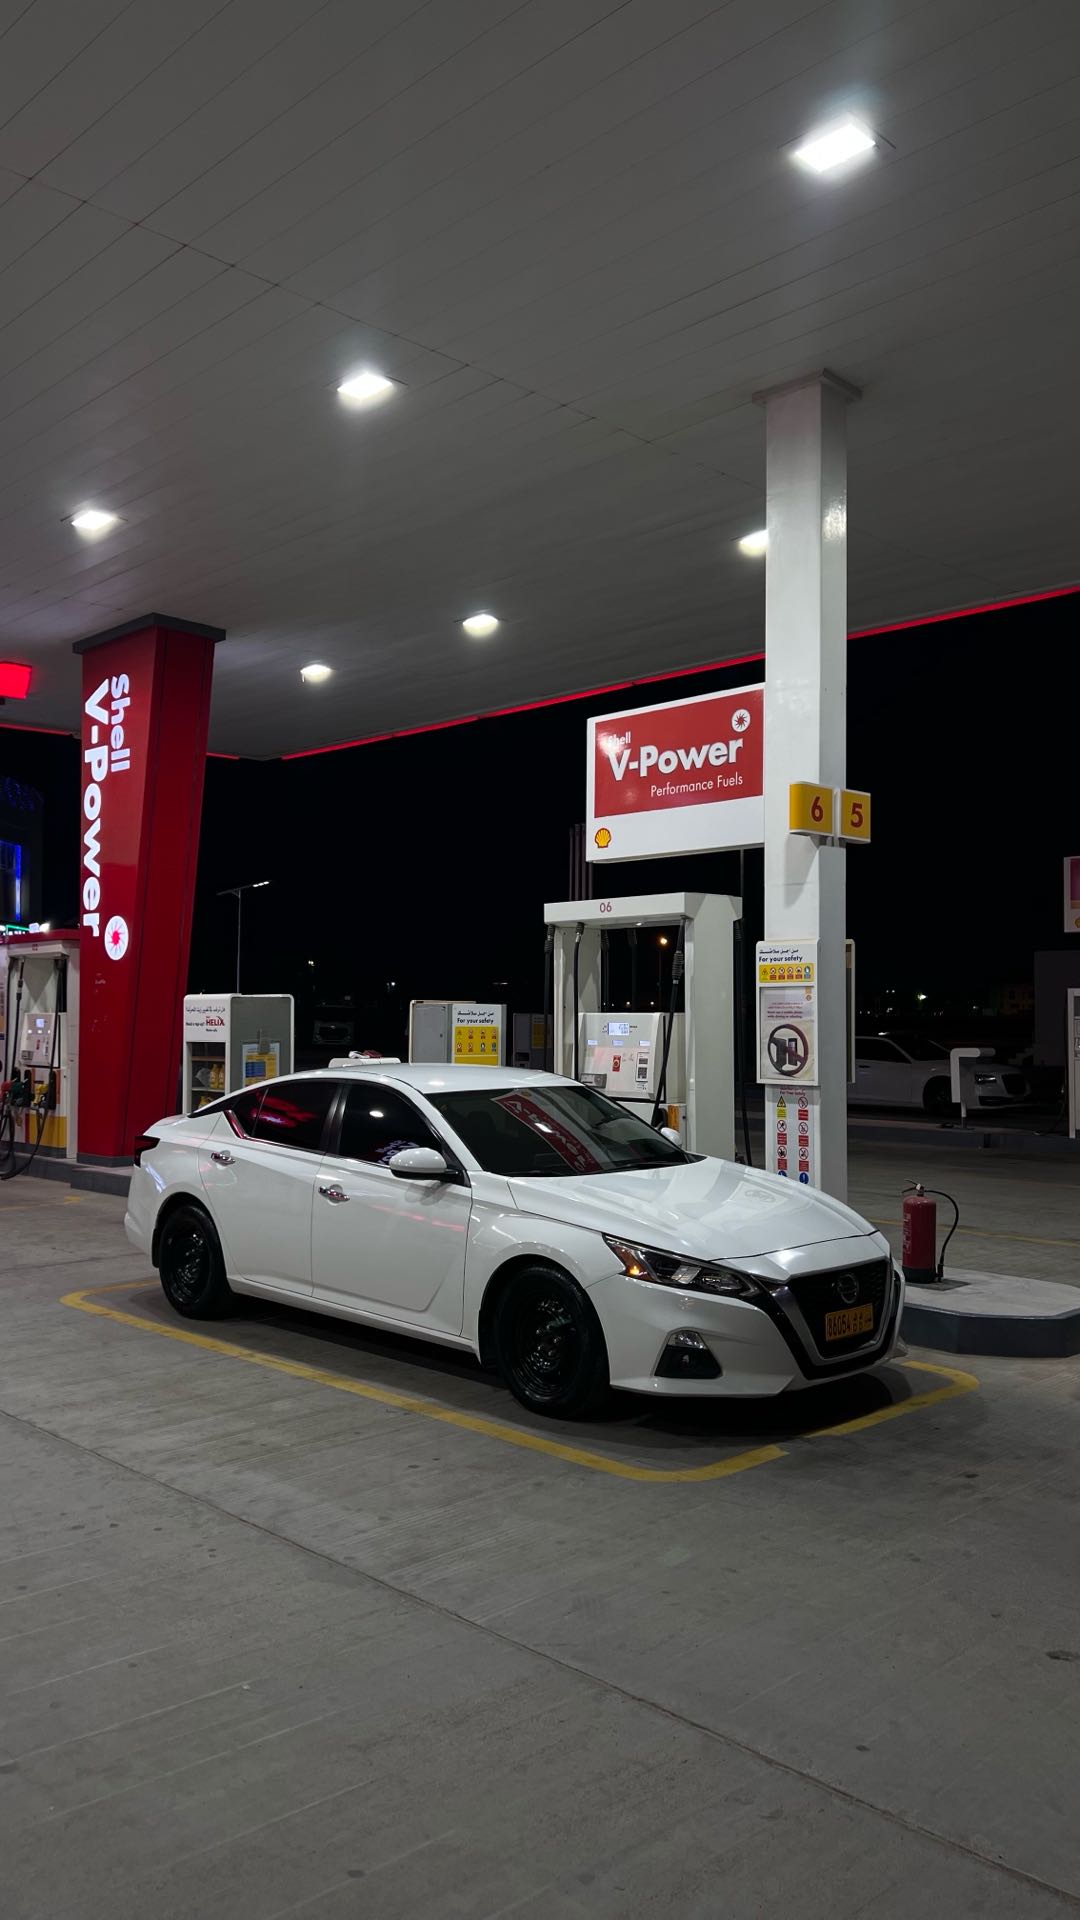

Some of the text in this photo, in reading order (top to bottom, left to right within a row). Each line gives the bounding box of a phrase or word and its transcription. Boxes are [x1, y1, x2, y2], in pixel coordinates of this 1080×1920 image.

[111, 673, 131, 772] Shell
[607, 738, 744, 782] V-Power
[651, 772, 743, 798] Performance Fuels
[83, 678, 109, 938] V-Power
[811, 796, 824, 823] 6
[850, 803, 864, 829] 5
[599, 901, 613, 913] 06
[784, 954, 803, 963] safety
[206, 1017, 225, 1027] HELIX
[478, 1017, 494, 1025] safety
